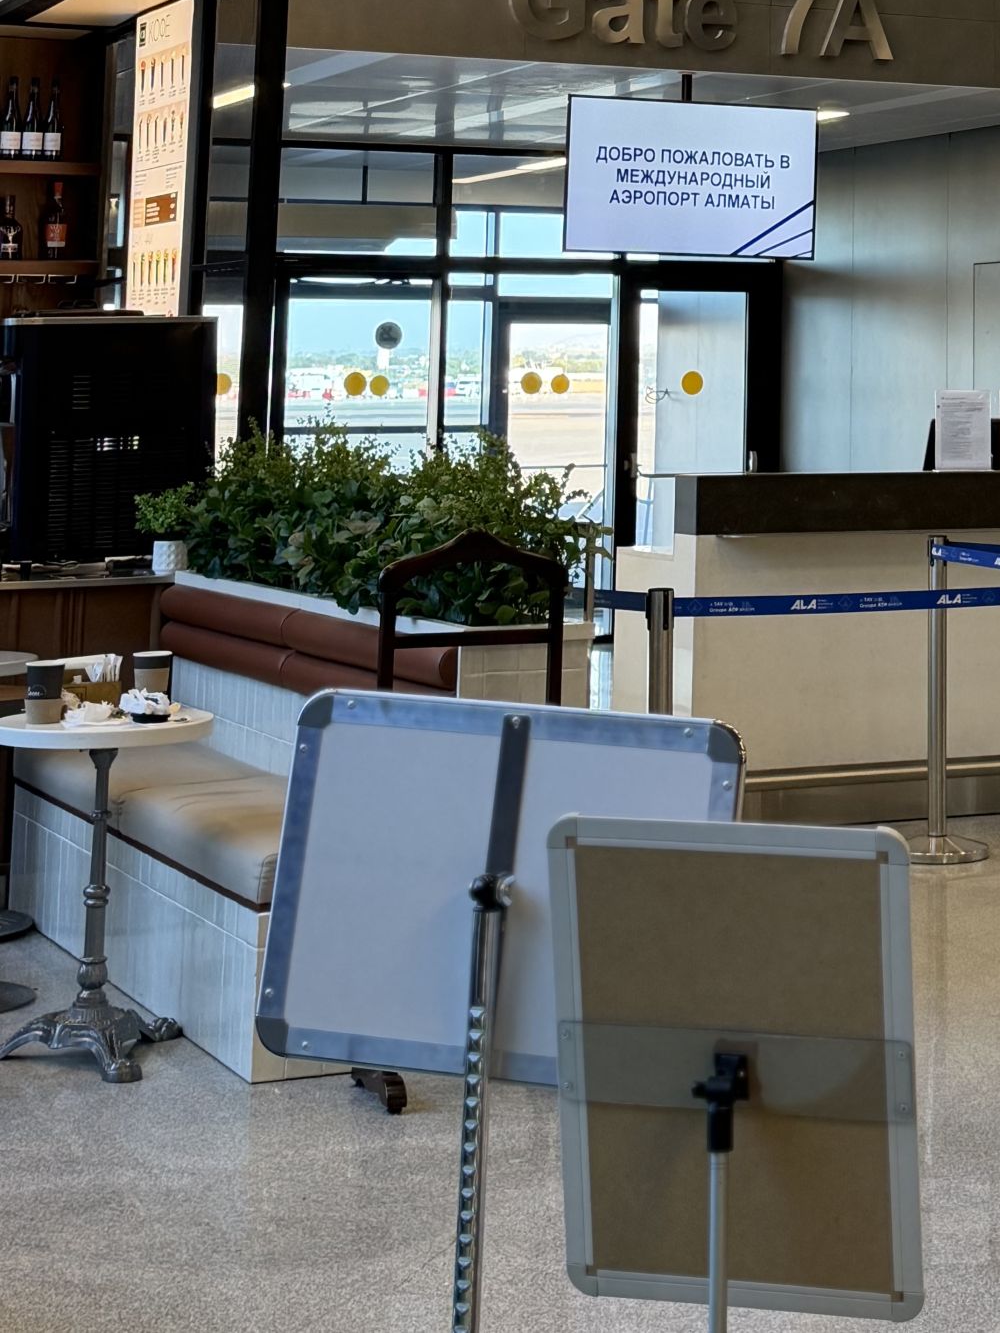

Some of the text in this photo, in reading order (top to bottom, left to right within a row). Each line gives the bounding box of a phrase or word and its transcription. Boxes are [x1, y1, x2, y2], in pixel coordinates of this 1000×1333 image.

[596, 145, 790, 169] ДОБРО ПОЖАЛОВАТЬ В
[616, 168, 771, 189] МЕЖДУНАРОДНЫЙ
[609, 189, 775, 210] АЭРОПОРТ АЛМАТЫ
[790, 599, 818, 611] ALA
[936, 594, 962, 605] ALA
